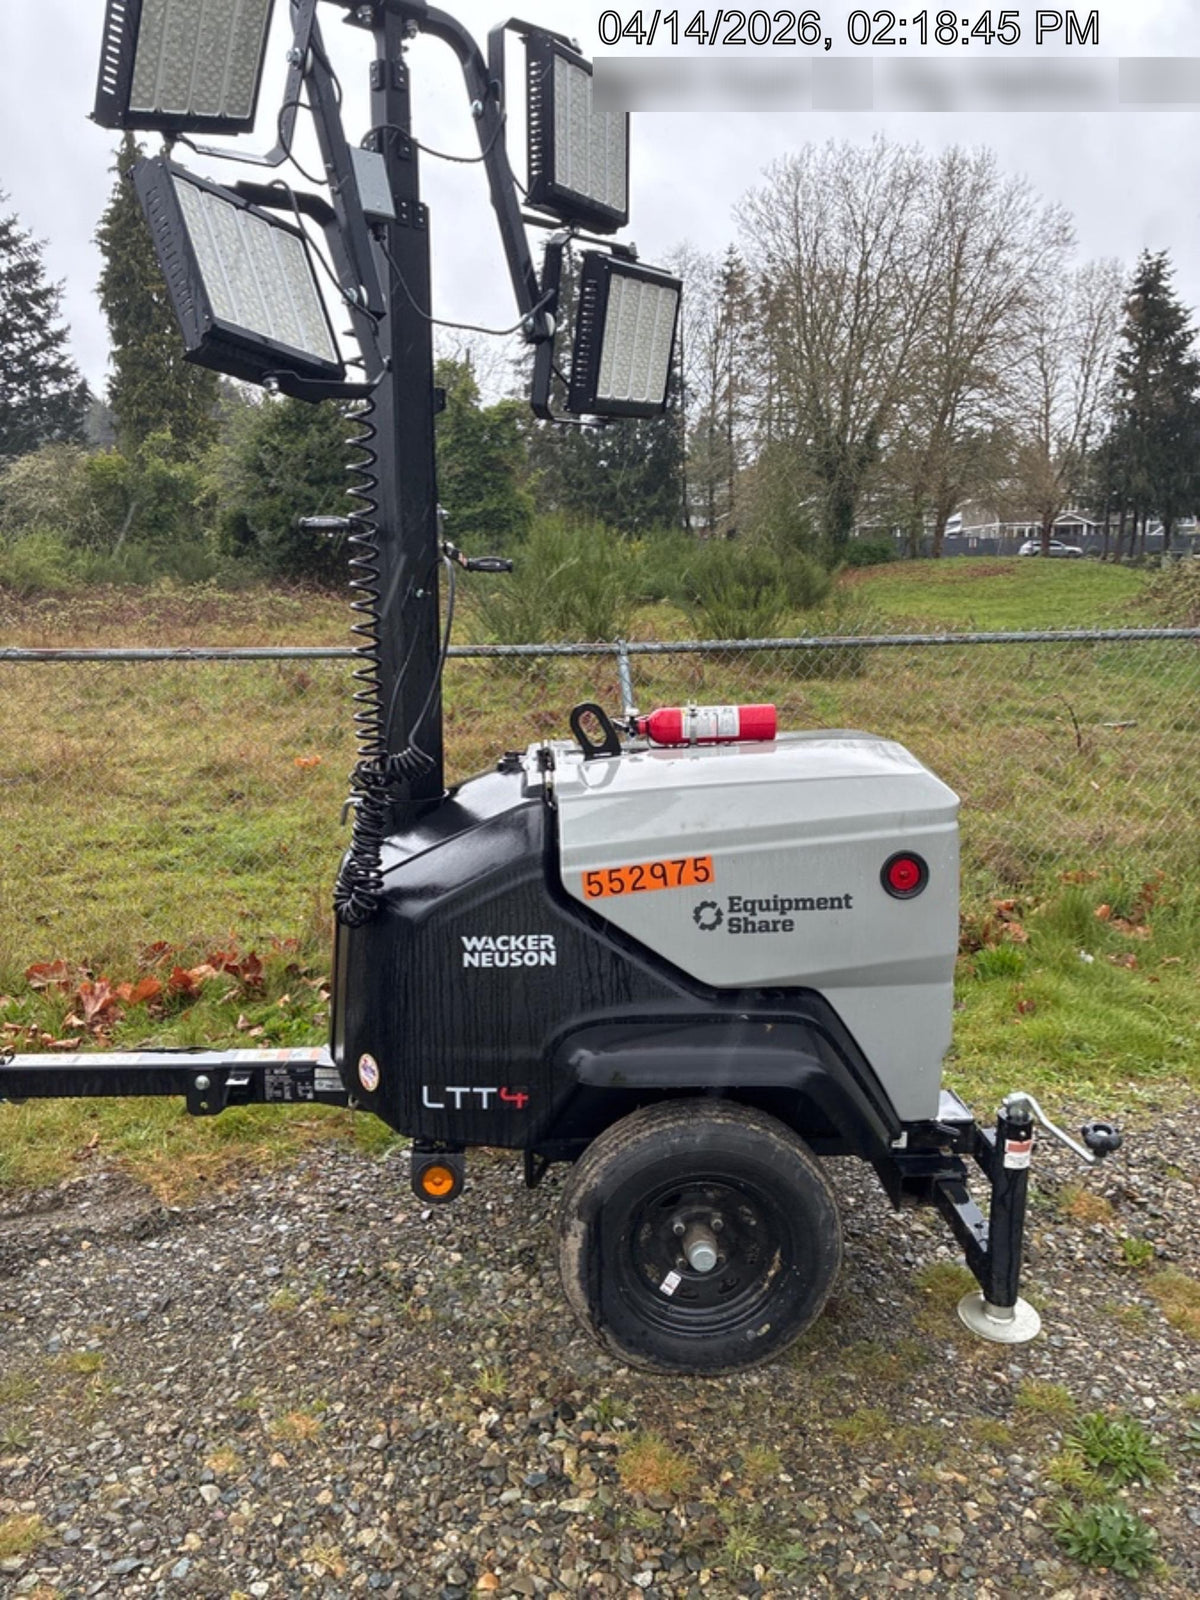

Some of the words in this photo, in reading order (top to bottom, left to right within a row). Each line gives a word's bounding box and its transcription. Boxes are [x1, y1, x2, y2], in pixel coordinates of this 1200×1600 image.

[585, 856, 711, 897] 552975
[727, 893, 853, 916] Equipment
[727, 916, 795, 934] Share
[461, 934, 556, 951] WACKER
[462, 951, 557, 968] NEUSON
[422, 1085, 529, 1110] LTT4
